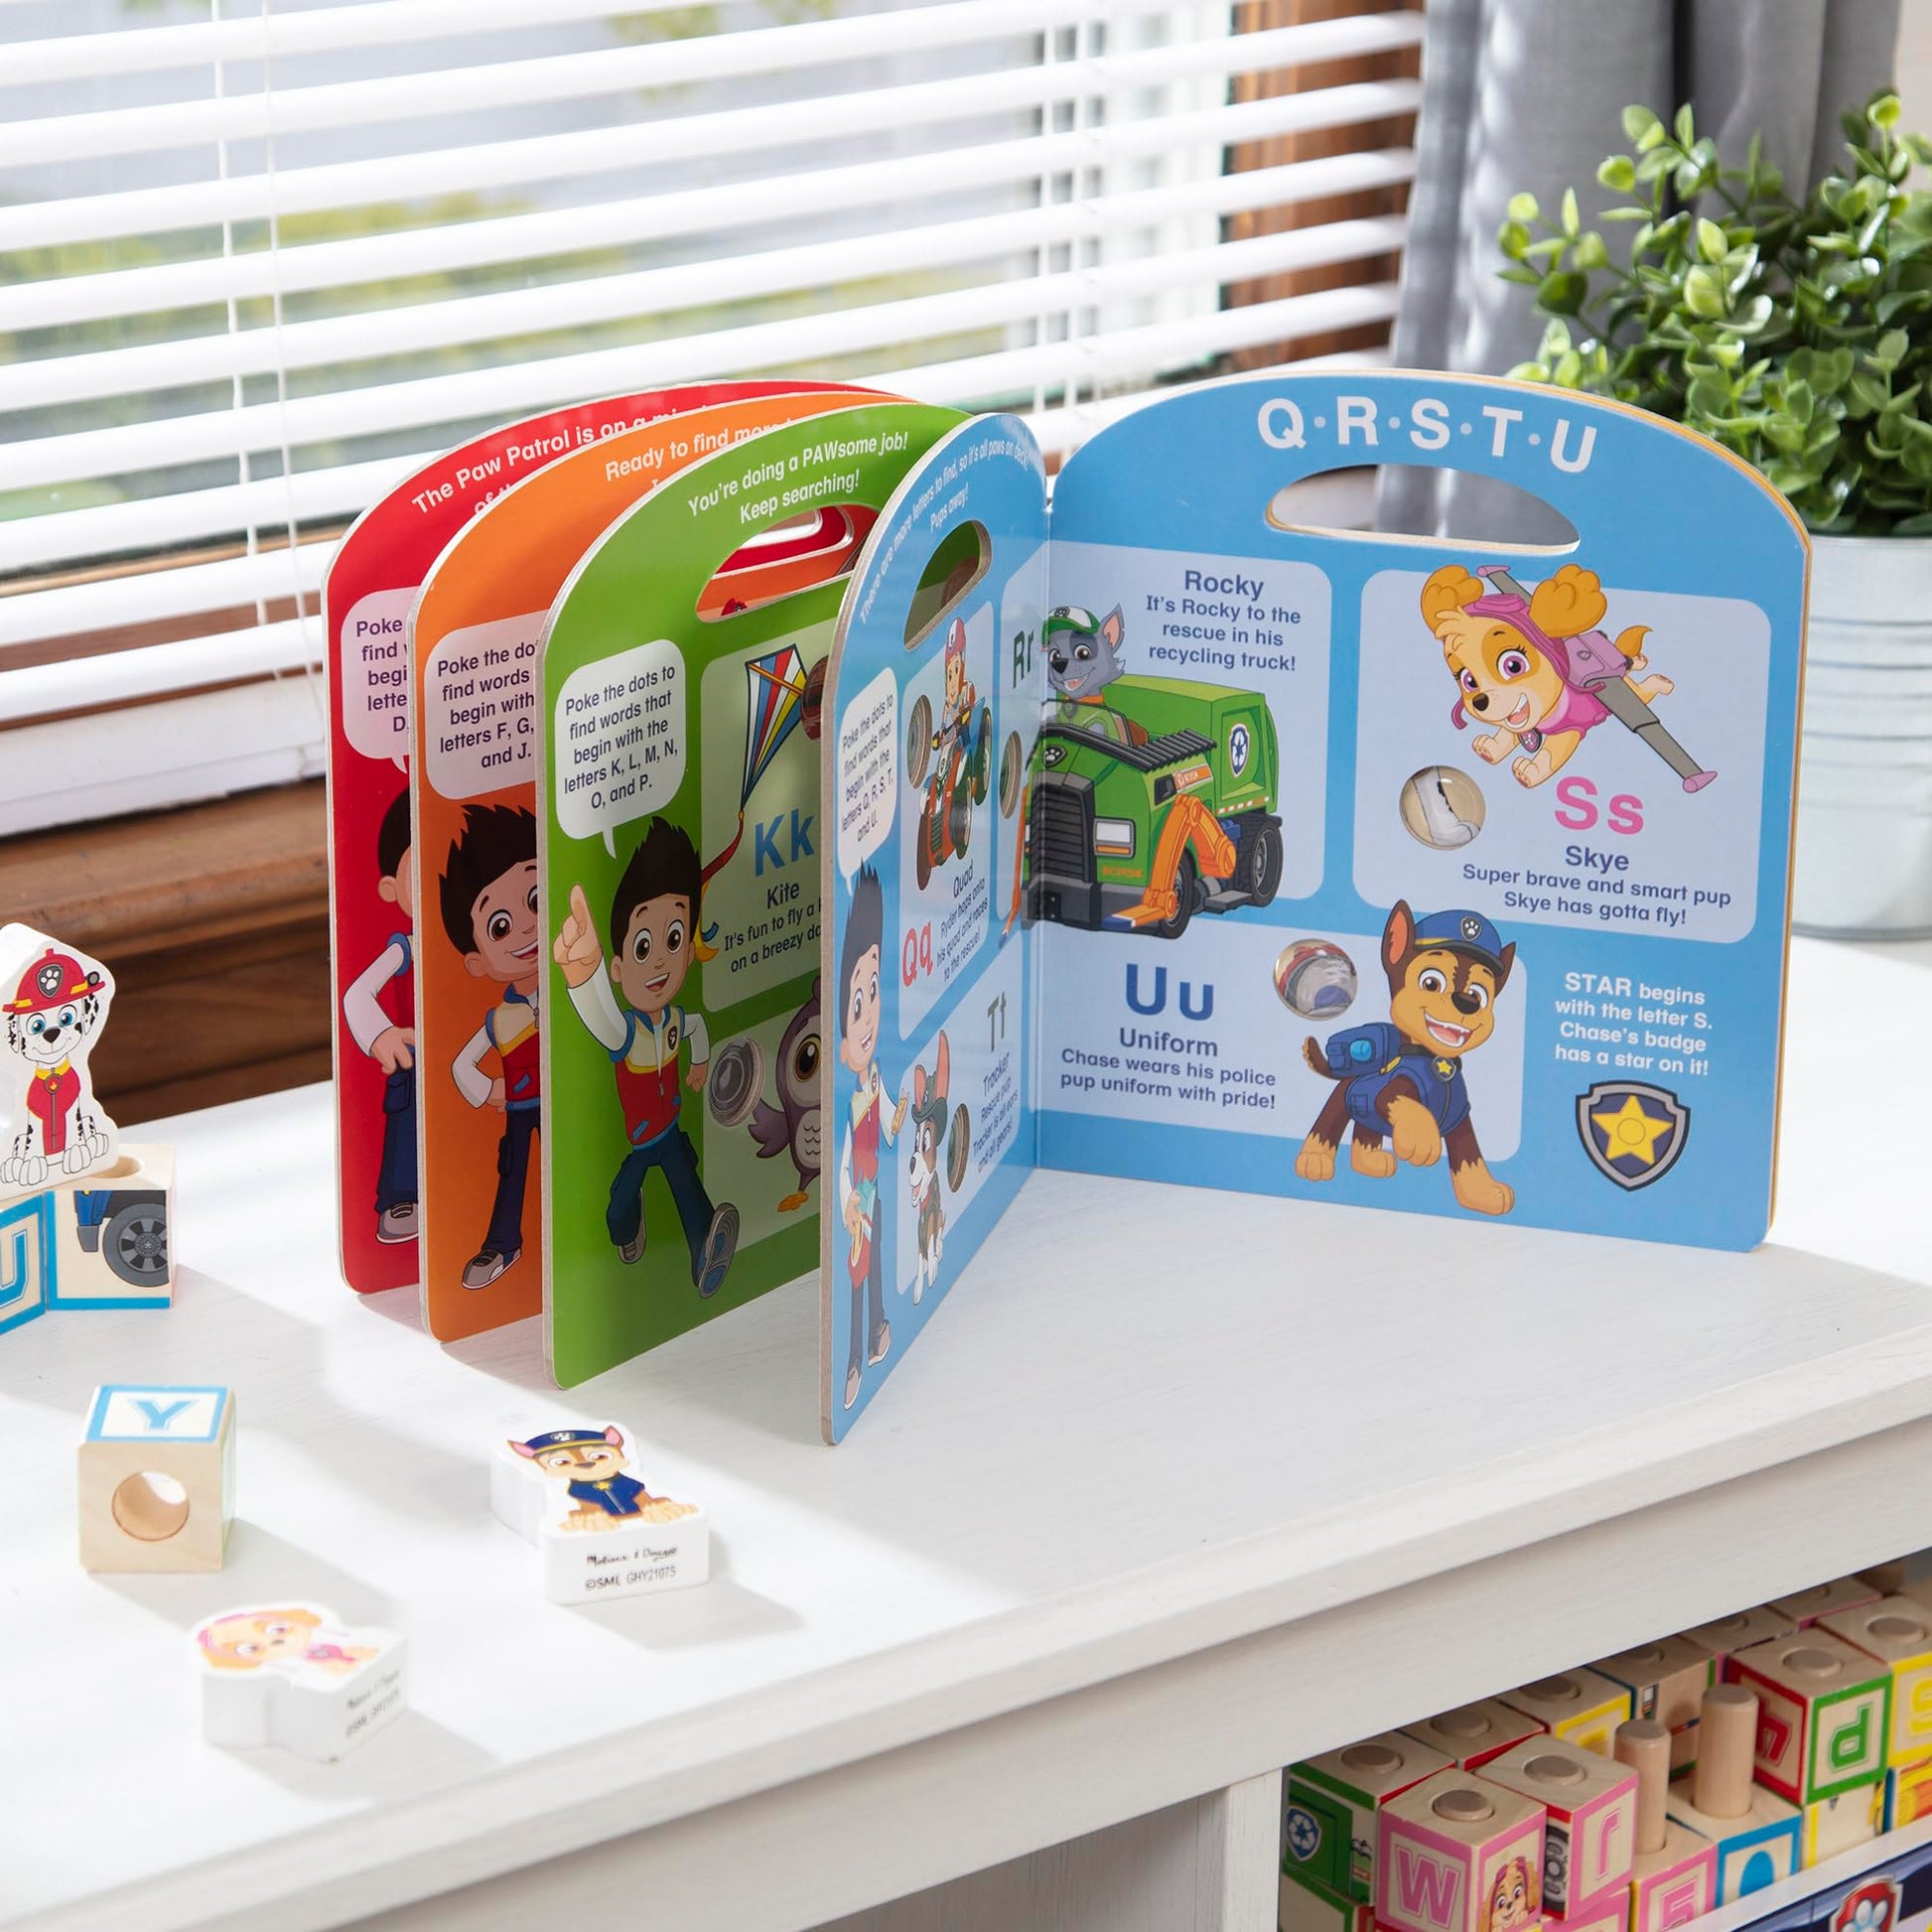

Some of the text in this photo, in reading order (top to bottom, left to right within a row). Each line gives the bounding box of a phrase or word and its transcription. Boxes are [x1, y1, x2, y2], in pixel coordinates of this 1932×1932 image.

[412, 482, 454, 513] The
[456, 457, 501, 489] Paw
[506, 429, 570, 467] Patrol
[575, 426, 596, 446] is
[600, 419, 626, 439] on
[605, 428, 730, 482] Ready to find
[687, 431, 908, 516] You're doing a PAWsome job!
[740, 468, 860, 524] Keep searching!
[1184, 570, 1265, 602] Rocky
[356, 619, 403, 637] Poke
[1146, 595, 1302, 624] It's Rocky to the
[361, 641, 398, 662] find
[1163, 622, 1284, 646] rescue in his
[368, 665, 407, 686] begi
[438, 648, 510, 677] Poke the
[1013, 629, 1035, 689] Rr
[1149, 644, 1297, 672] recycling truck!
[442, 668, 530, 702] find words
[565, 665, 676, 716] Poke the dots to
[450, 692, 535, 726] begin with
[569, 690, 672, 741] find words that
[440, 717, 534, 754] letters F, G,
[574, 719, 669, 764] begin with the
[481, 742, 532, 768] and J.
[564, 739, 679, 794] letters K, L, M, N,
[591, 773, 652, 810] O, and P.
[1554, 775, 1645, 835] Ss
[755, 808, 815, 878] Kk
[1565, 845, 1630, 875] Skye
[766, 882, 800, 909] Kite
[953, 859, 974, 898] Quad
[1462, 864, 1731, 908] Super brave and smart pup
[725, 931, 745, 952] It's
[747, 921, 768, 943] fun
[771, 915, 784, 930] to
[787, 906, 803, 926] fly
[806, 902, 815, 916] a
[1504, 892, 1687, 927] Skye has gotta fly!
[731, 923, 821, 973] on a breezy da
[902, 920, 934, 987] Qq
[1126, 963, 1214, 1021] Uu
[1565, 971, 1706, 1006] STAR begins
[988, 991, 1006, 1052] Tt
[1555, 999, 1713, 1030] with the letter S.
[1119, 1027, 1218, 1057] Uniform
[1560, 1021, 1707, 1054] Chase's badge
[1061, 1048, 1277, 1087] Chase wears his police
[1555, 1043, 1709, 1076] has a star on it!
[1060, 1072, 1276, 1110] pup uniform with pride!
[128, 1399, 200, 1430] Y
[1396, 1843, 1460, 1929] W
